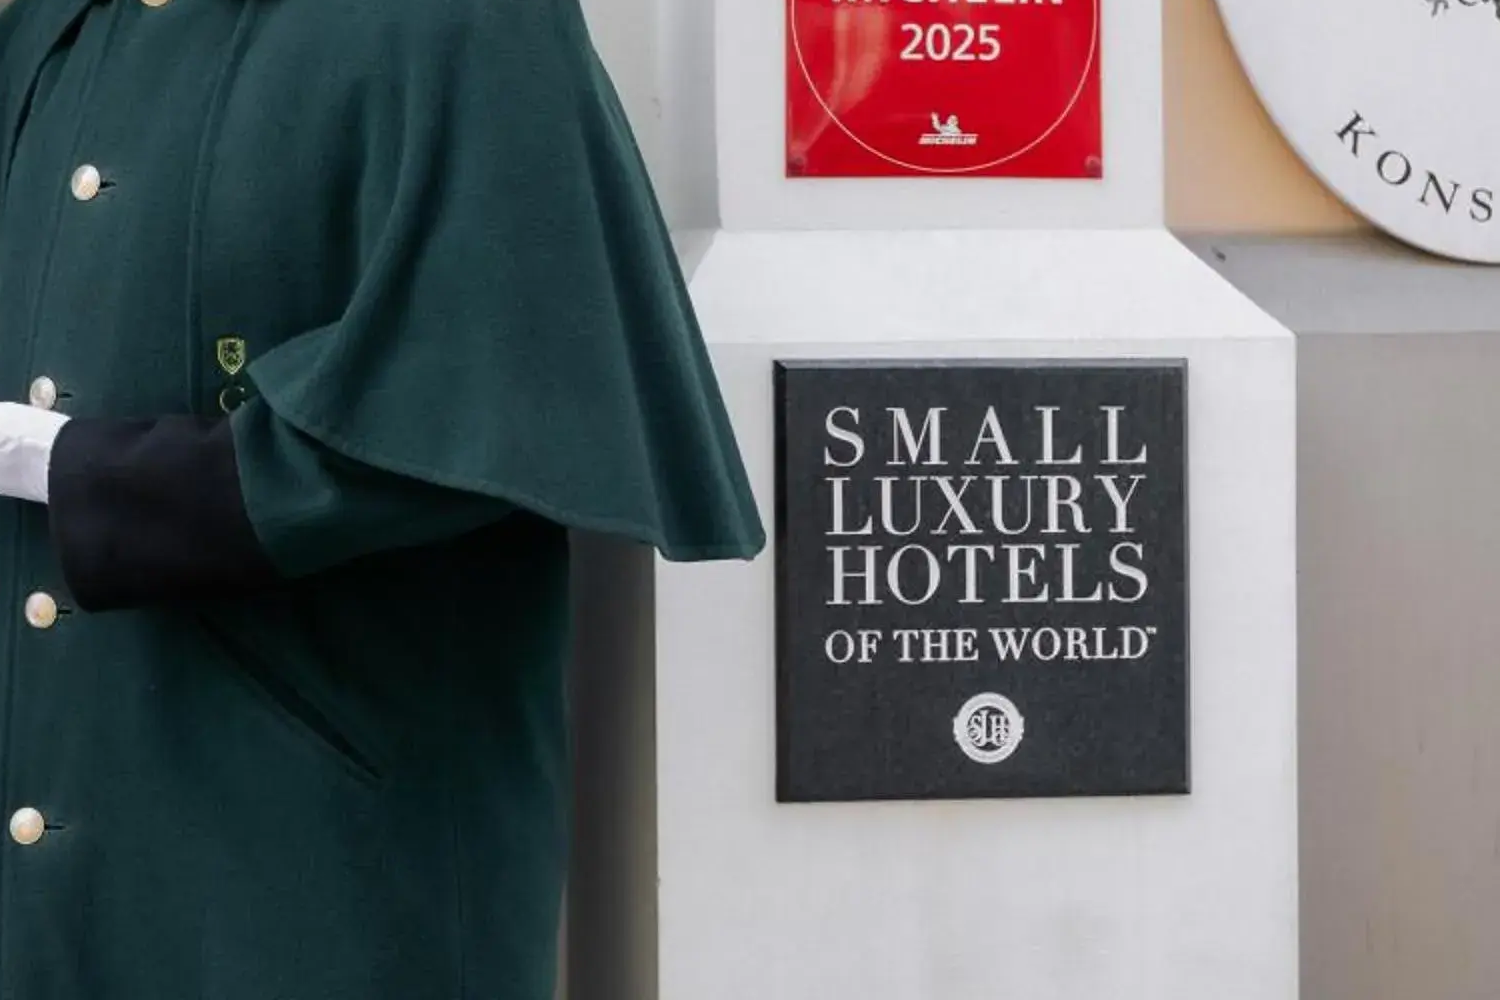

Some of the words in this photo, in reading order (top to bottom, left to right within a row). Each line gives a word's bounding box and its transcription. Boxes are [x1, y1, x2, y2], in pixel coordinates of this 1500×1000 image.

[900, 23, 1001, 61] 2025
[1334, 110, 1494, 223] KONS
[824, 405, 1147, 467] SMALL
[825, 475, 1146, 535] LUXURY
[826, 542, 1149, 605] HOTELS
[825, 629, 882, 663] OF
[892, 629, 979, 662] THE
